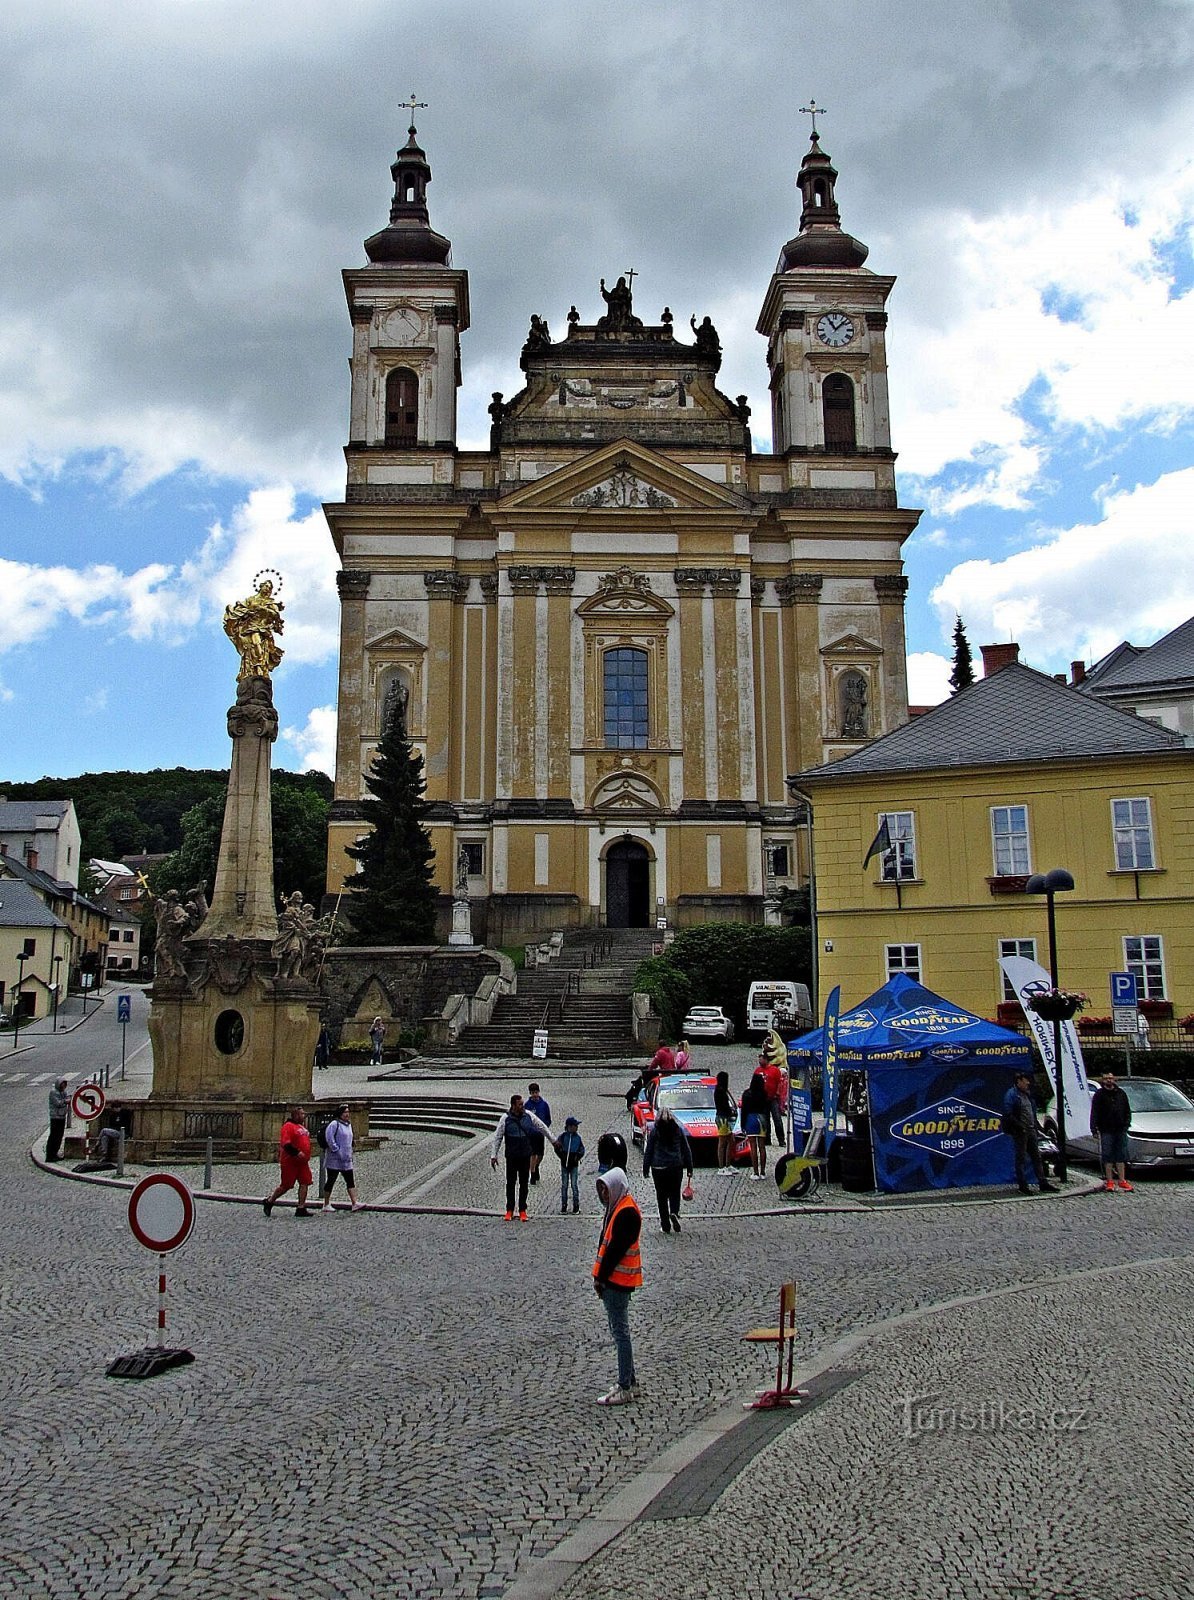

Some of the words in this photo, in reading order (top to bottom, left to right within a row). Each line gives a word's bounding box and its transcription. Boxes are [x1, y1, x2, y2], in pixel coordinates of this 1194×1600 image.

[1116, 976, 1131, 997] P
[891, 1014, 970, 1027] GOODYEAR
[867, 1049, 922, 1060] GOODYEAR
[975, 1045, 1029, 1056] GOODYEAR
[937, 1106, 966, 1115] SINCE
[902, 1115, 1001, 1137] GOODYEAR
[940, 1138, 965, 1150] 1898
